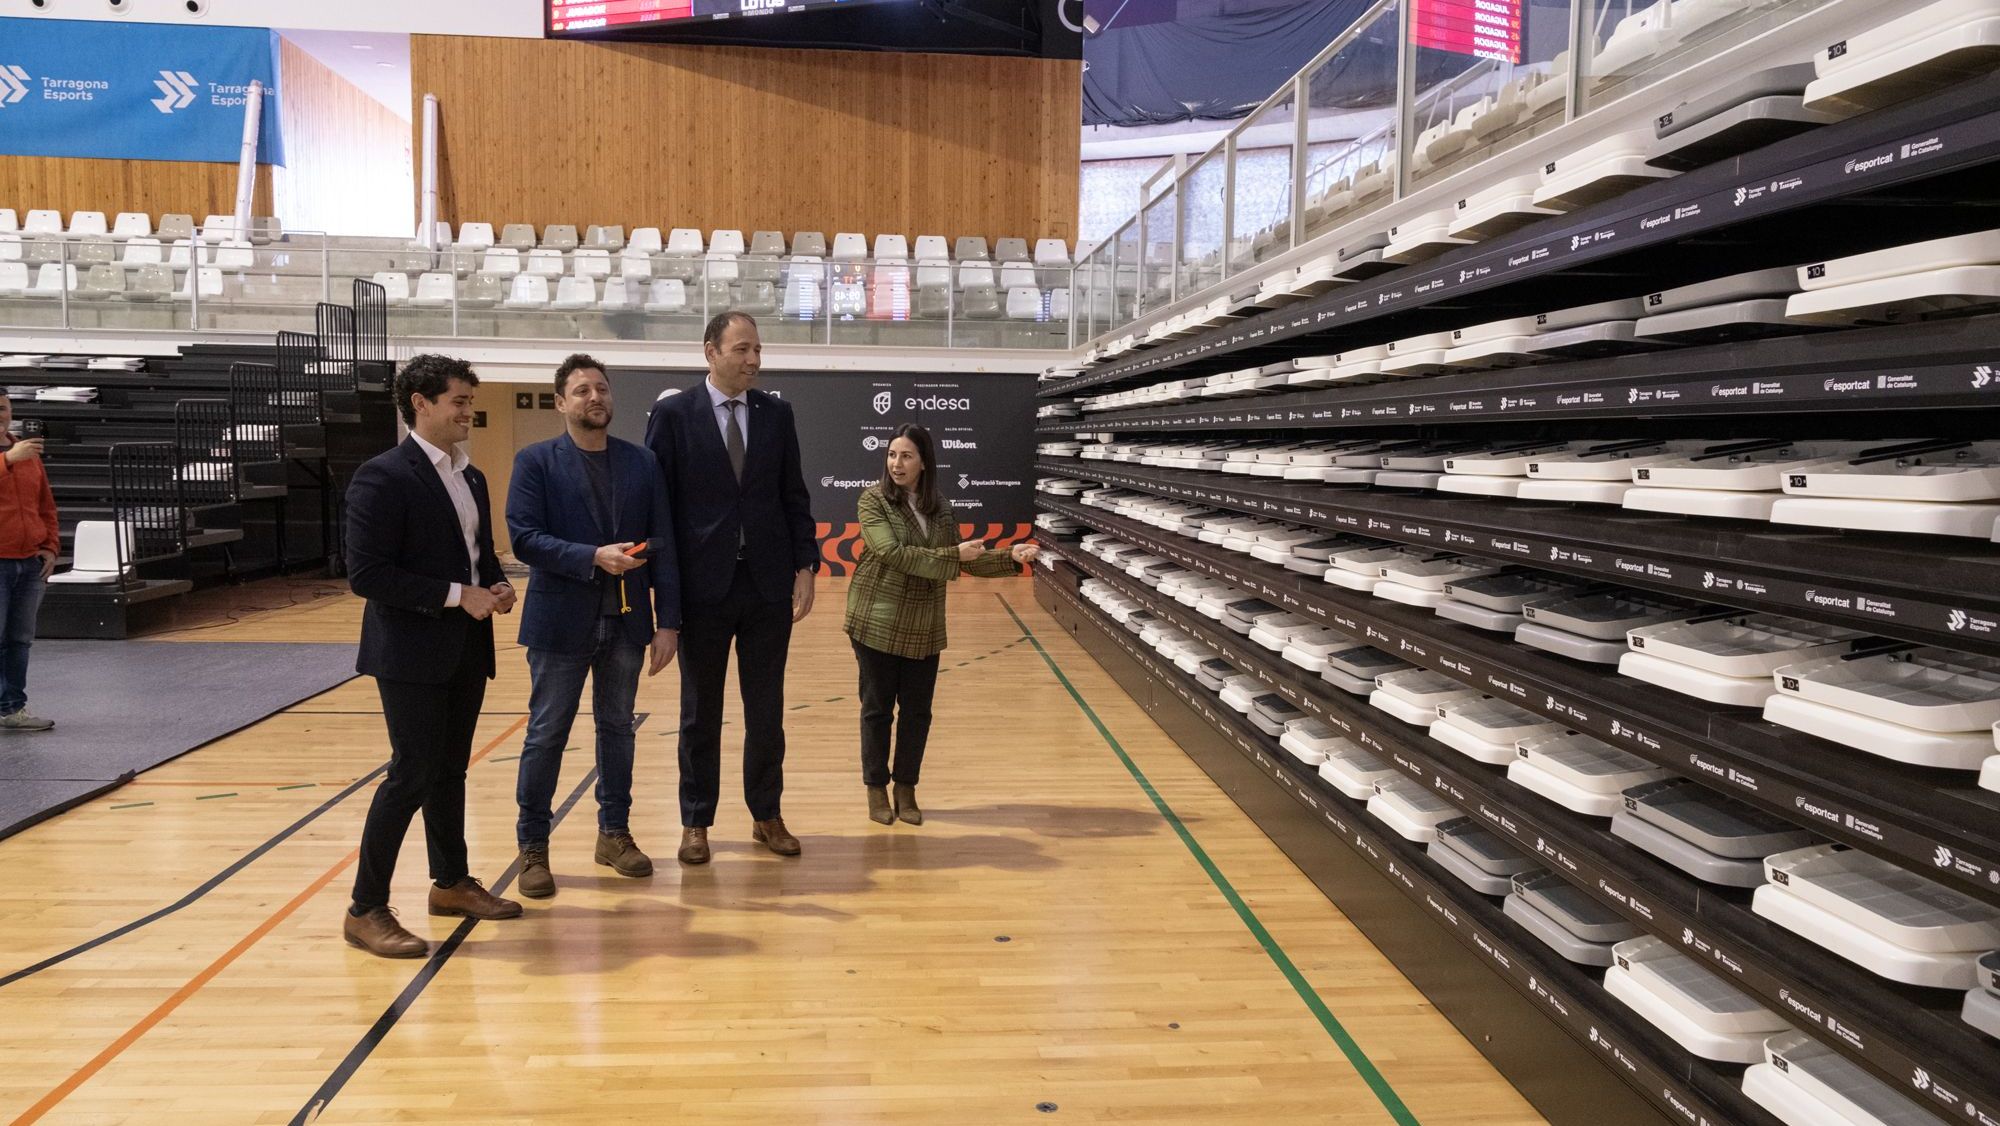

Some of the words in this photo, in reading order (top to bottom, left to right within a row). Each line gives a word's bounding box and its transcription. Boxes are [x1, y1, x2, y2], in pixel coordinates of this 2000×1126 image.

[41, 76, 109, 91] Tarragona
[43, 88, 94, 101] Esports
[211, 94, 248, 107] Espor
[1911, 136, 1939, 150] Generalitat
[1917, 143, 1944, 155] Catalunya
[1854, 152, 1893, 172] esportcat
[1646, 213, 1671, 229] esportcat
[1718, 386, 1748, 398] esportcat
[1833, 380, 1870, 392] esportcat
[904, 394, 970, 410] endesa
[941, 439, 977, 449] Wilson
[1813, 594, 1850, 608] esportcat
[1866, 600, 1892, 609] Generalitat
[1872, 606, 1895, 616] Catalunya
[1969, 617, 1997, 628] Tarragona
[1969, 624, 1991, 633] Esports
[1697, 759, 1724, 777] esportcat
[1804, 803, 1840, 823] esportcat
[1787, 997, 1822, 1023] esportcat
